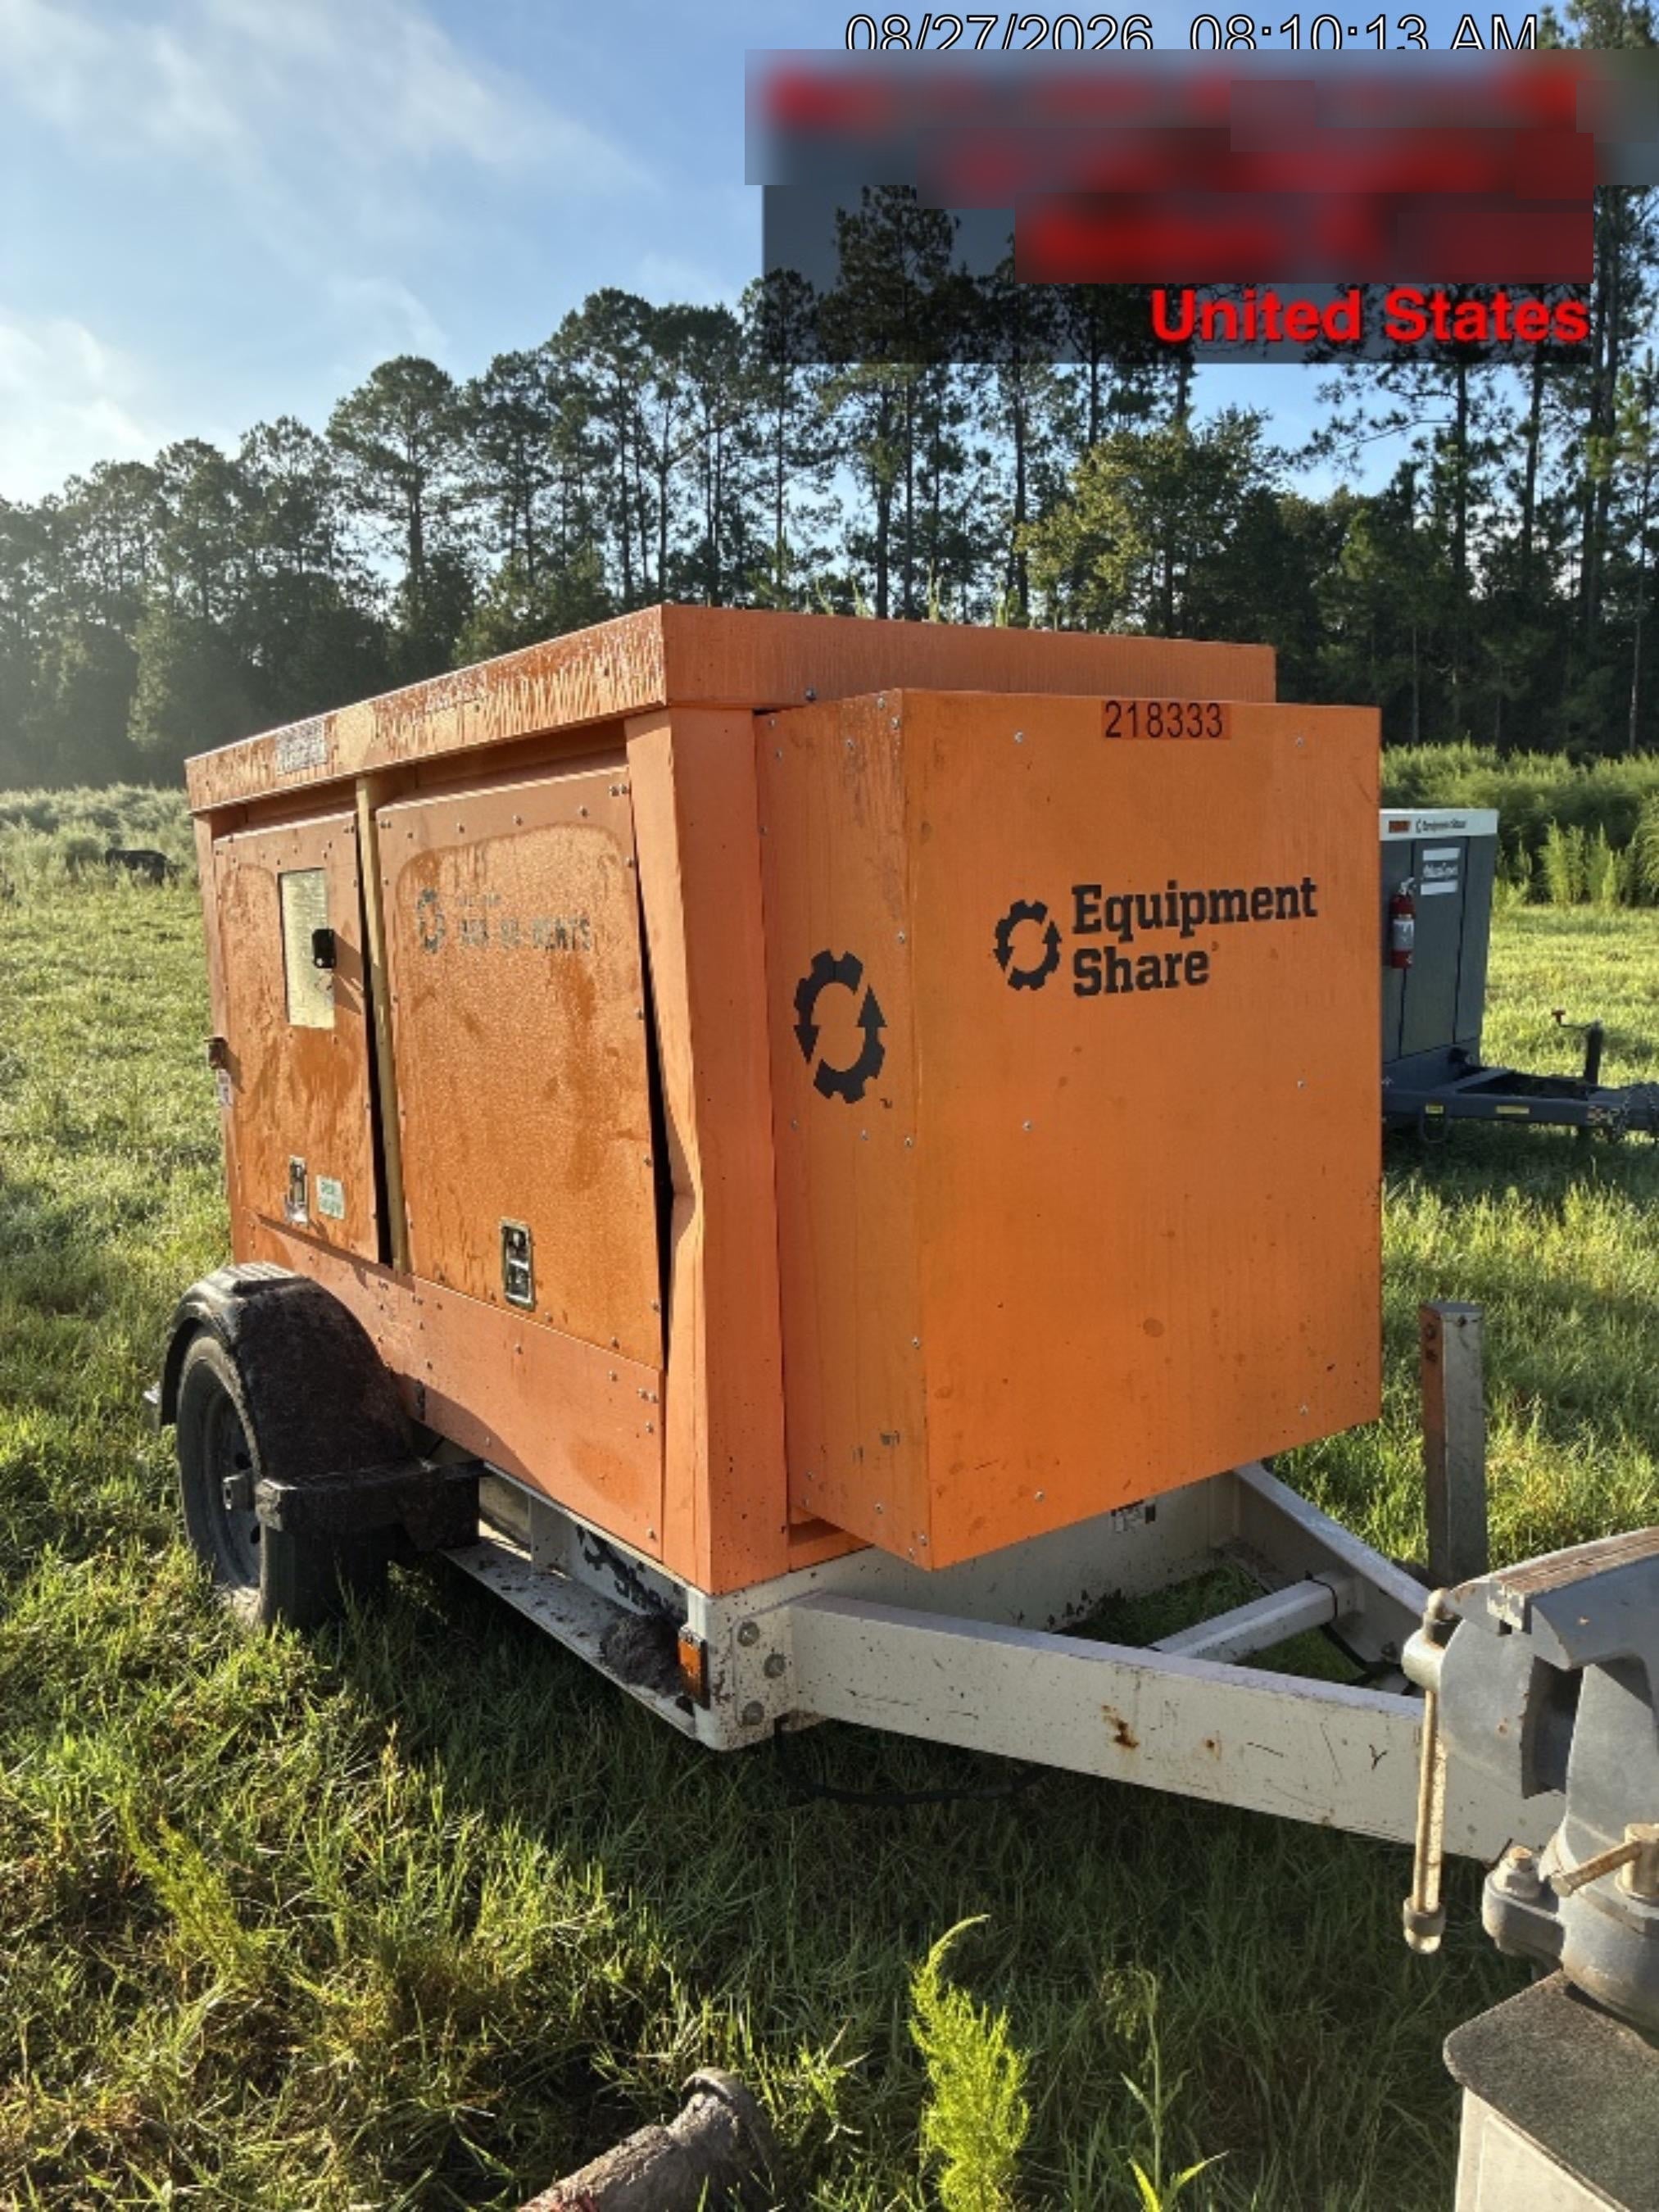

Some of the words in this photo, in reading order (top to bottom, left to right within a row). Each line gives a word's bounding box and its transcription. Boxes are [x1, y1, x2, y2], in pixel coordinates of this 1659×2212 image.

[1104, 700, 1224, 738] 218333
[1072, 877, 1318, 943] Equipment
[1072, 945, 1210, 997] Share
